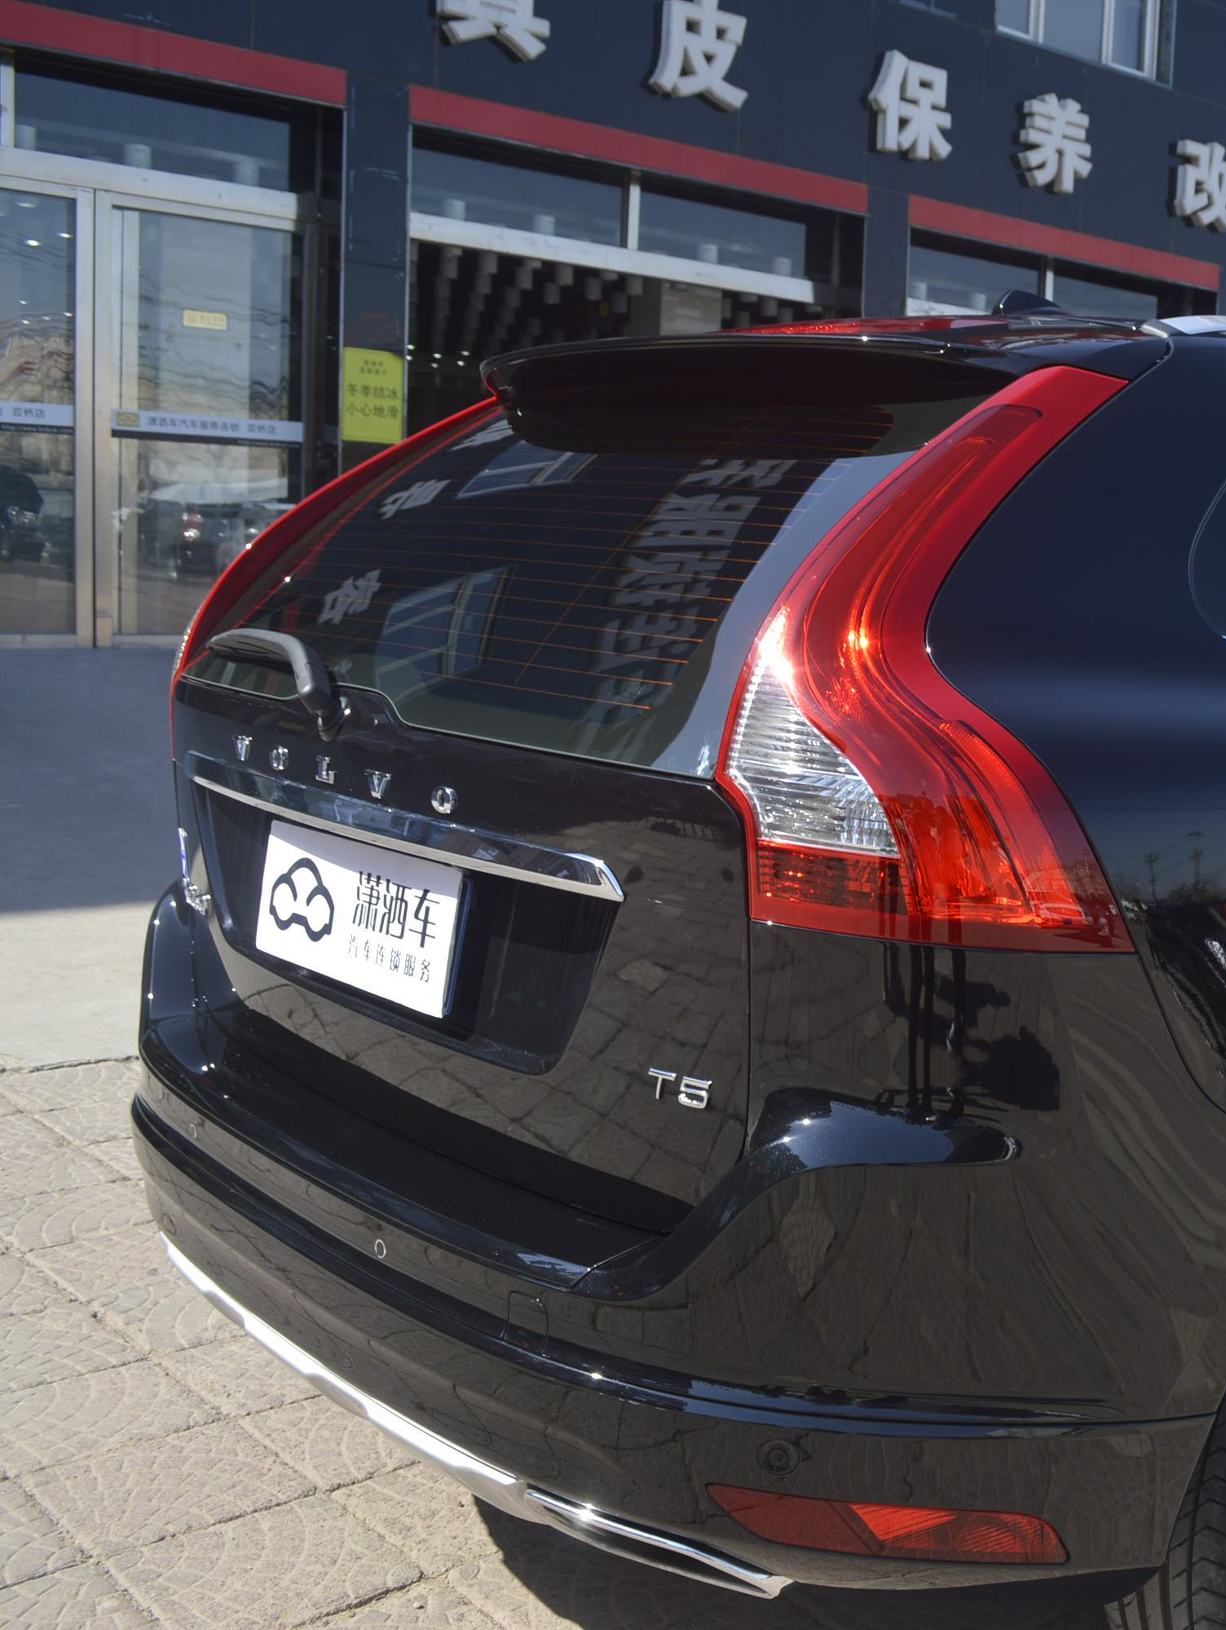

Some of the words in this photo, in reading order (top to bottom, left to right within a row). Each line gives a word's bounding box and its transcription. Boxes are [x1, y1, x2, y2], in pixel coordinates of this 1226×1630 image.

[233, 735, 459, 815] VOLVO
[352, 870, 440, 948] 潇洒车
[648, 1067, 713, 1109] T5
